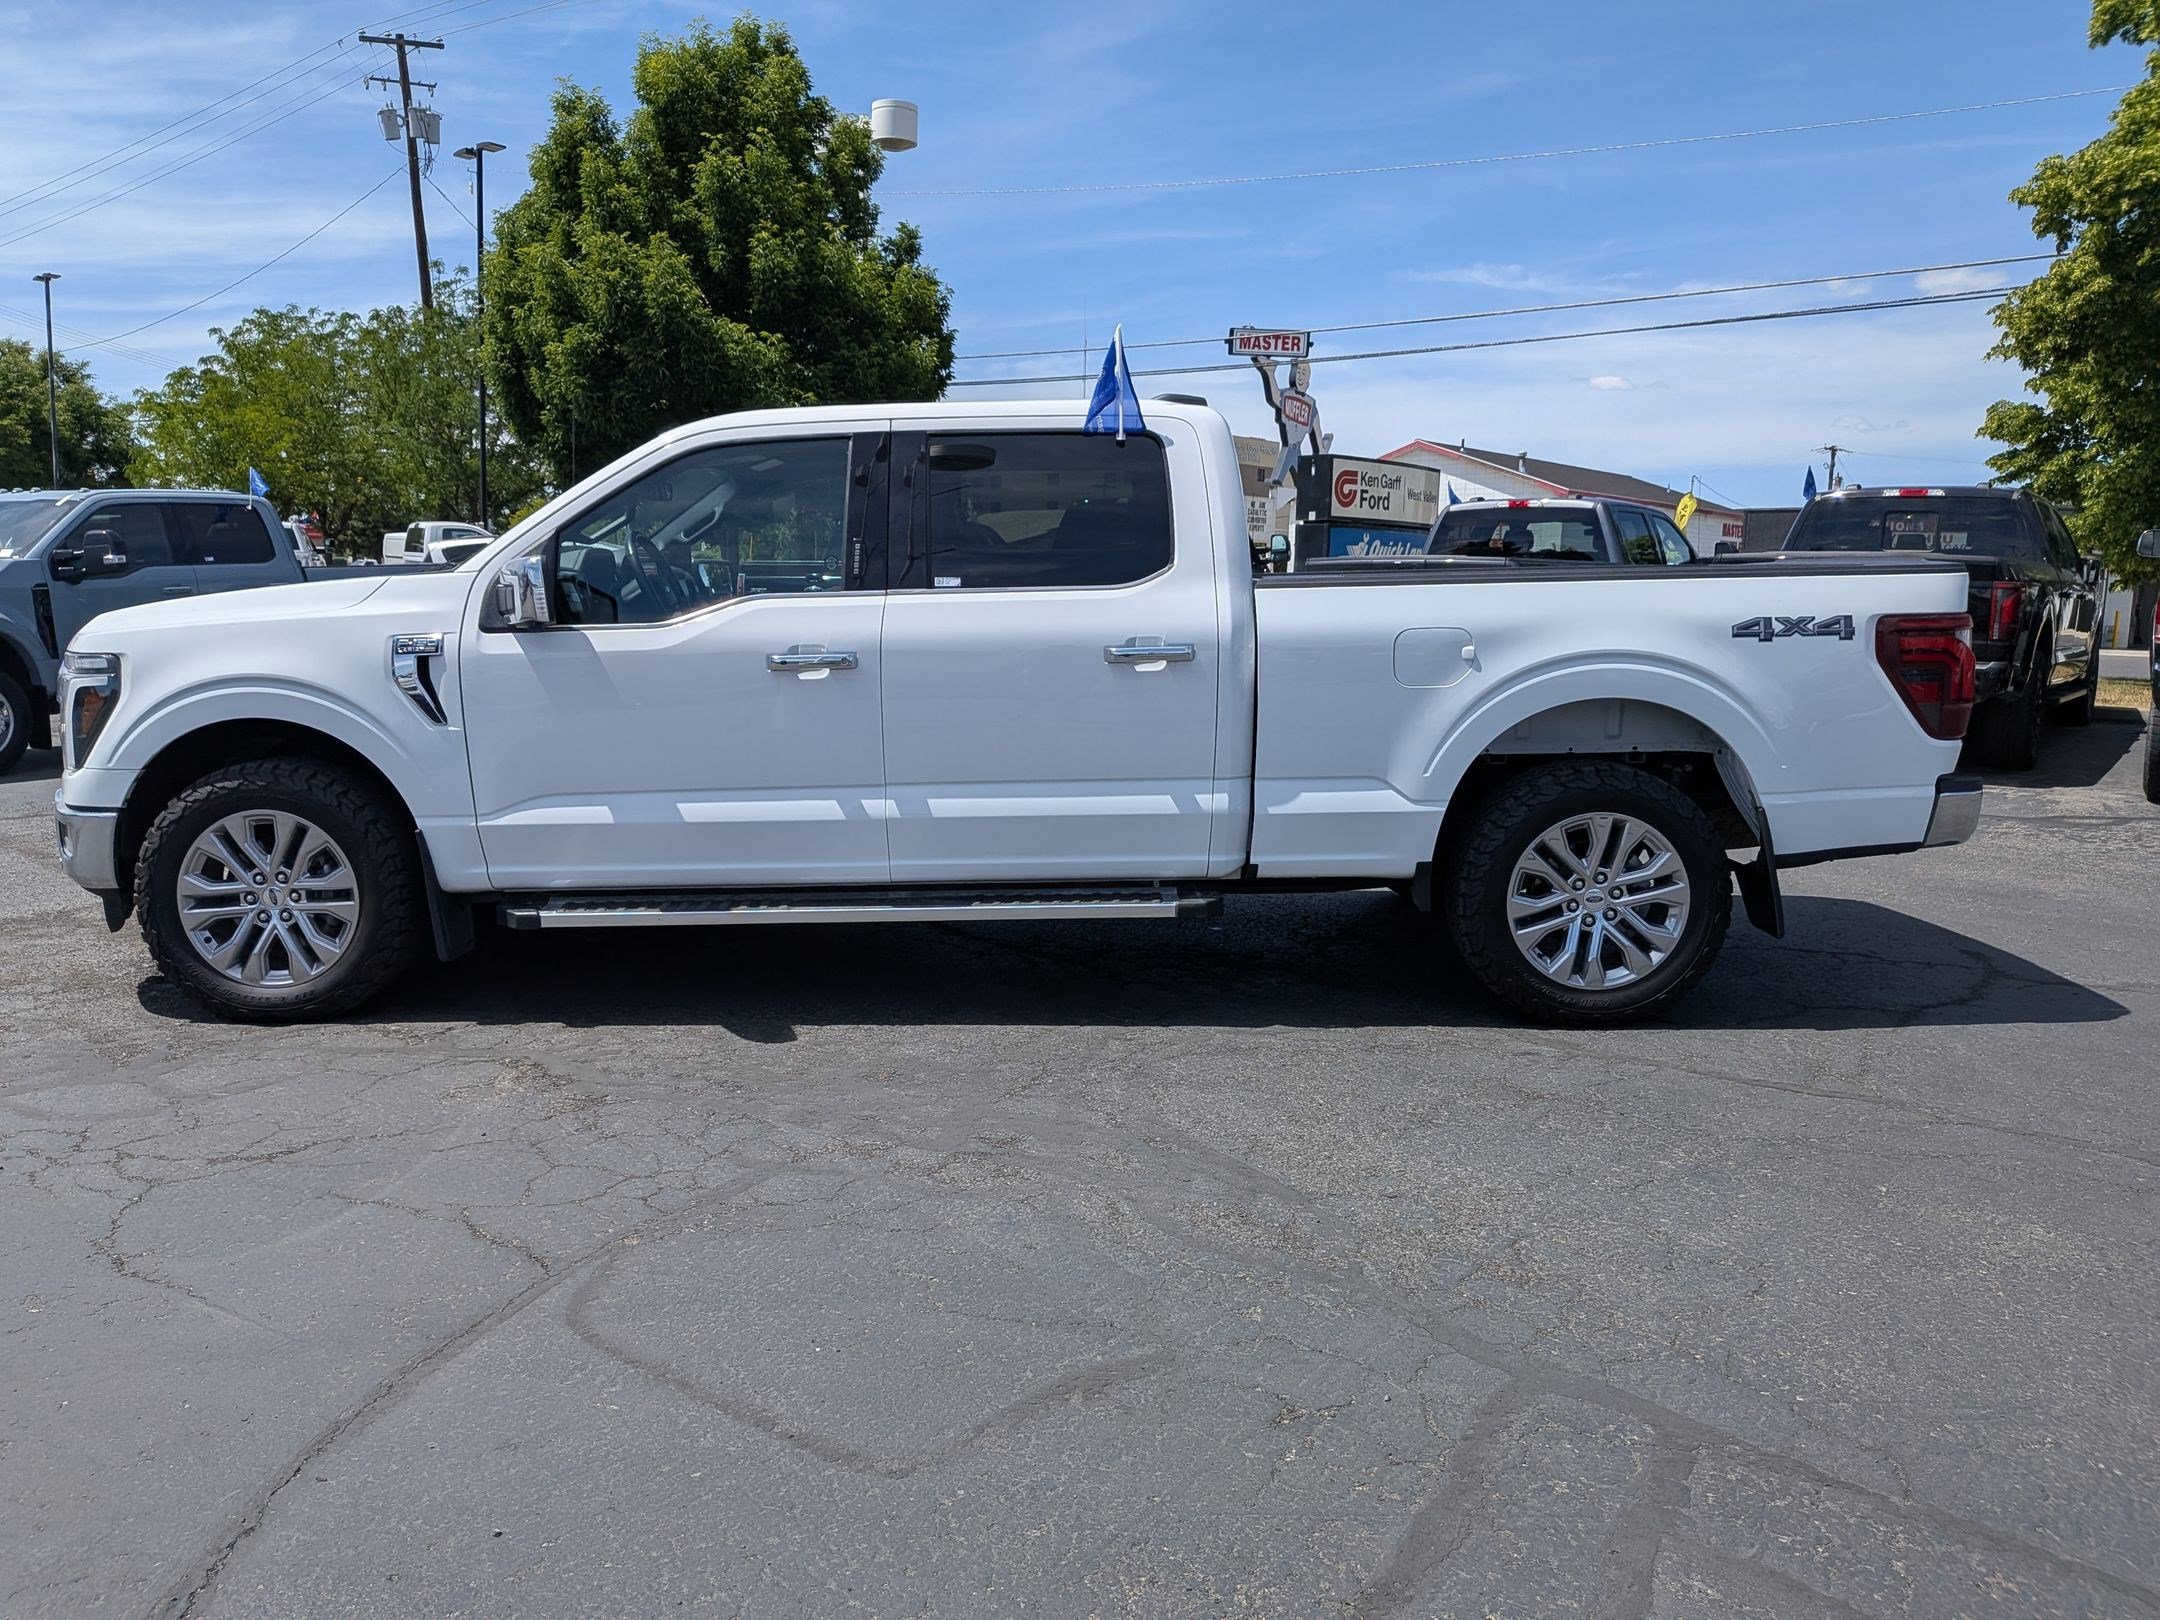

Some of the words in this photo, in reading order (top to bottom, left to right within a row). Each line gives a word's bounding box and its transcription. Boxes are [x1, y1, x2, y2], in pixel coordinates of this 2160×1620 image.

[1240, 335, 1301, 352] MASTER
[1284, 397, 1310, 424] MUFFLER
[1360, 471, 1380, 488] Ken
[1380, 473, 1402, 491] Garff
[1359, 489, 1391, 512] Ford
[1407, 487, 1422, 502] West
[1423, 490, 1438, 507] Valley
[1369, 539, 1404, 556] Quick
